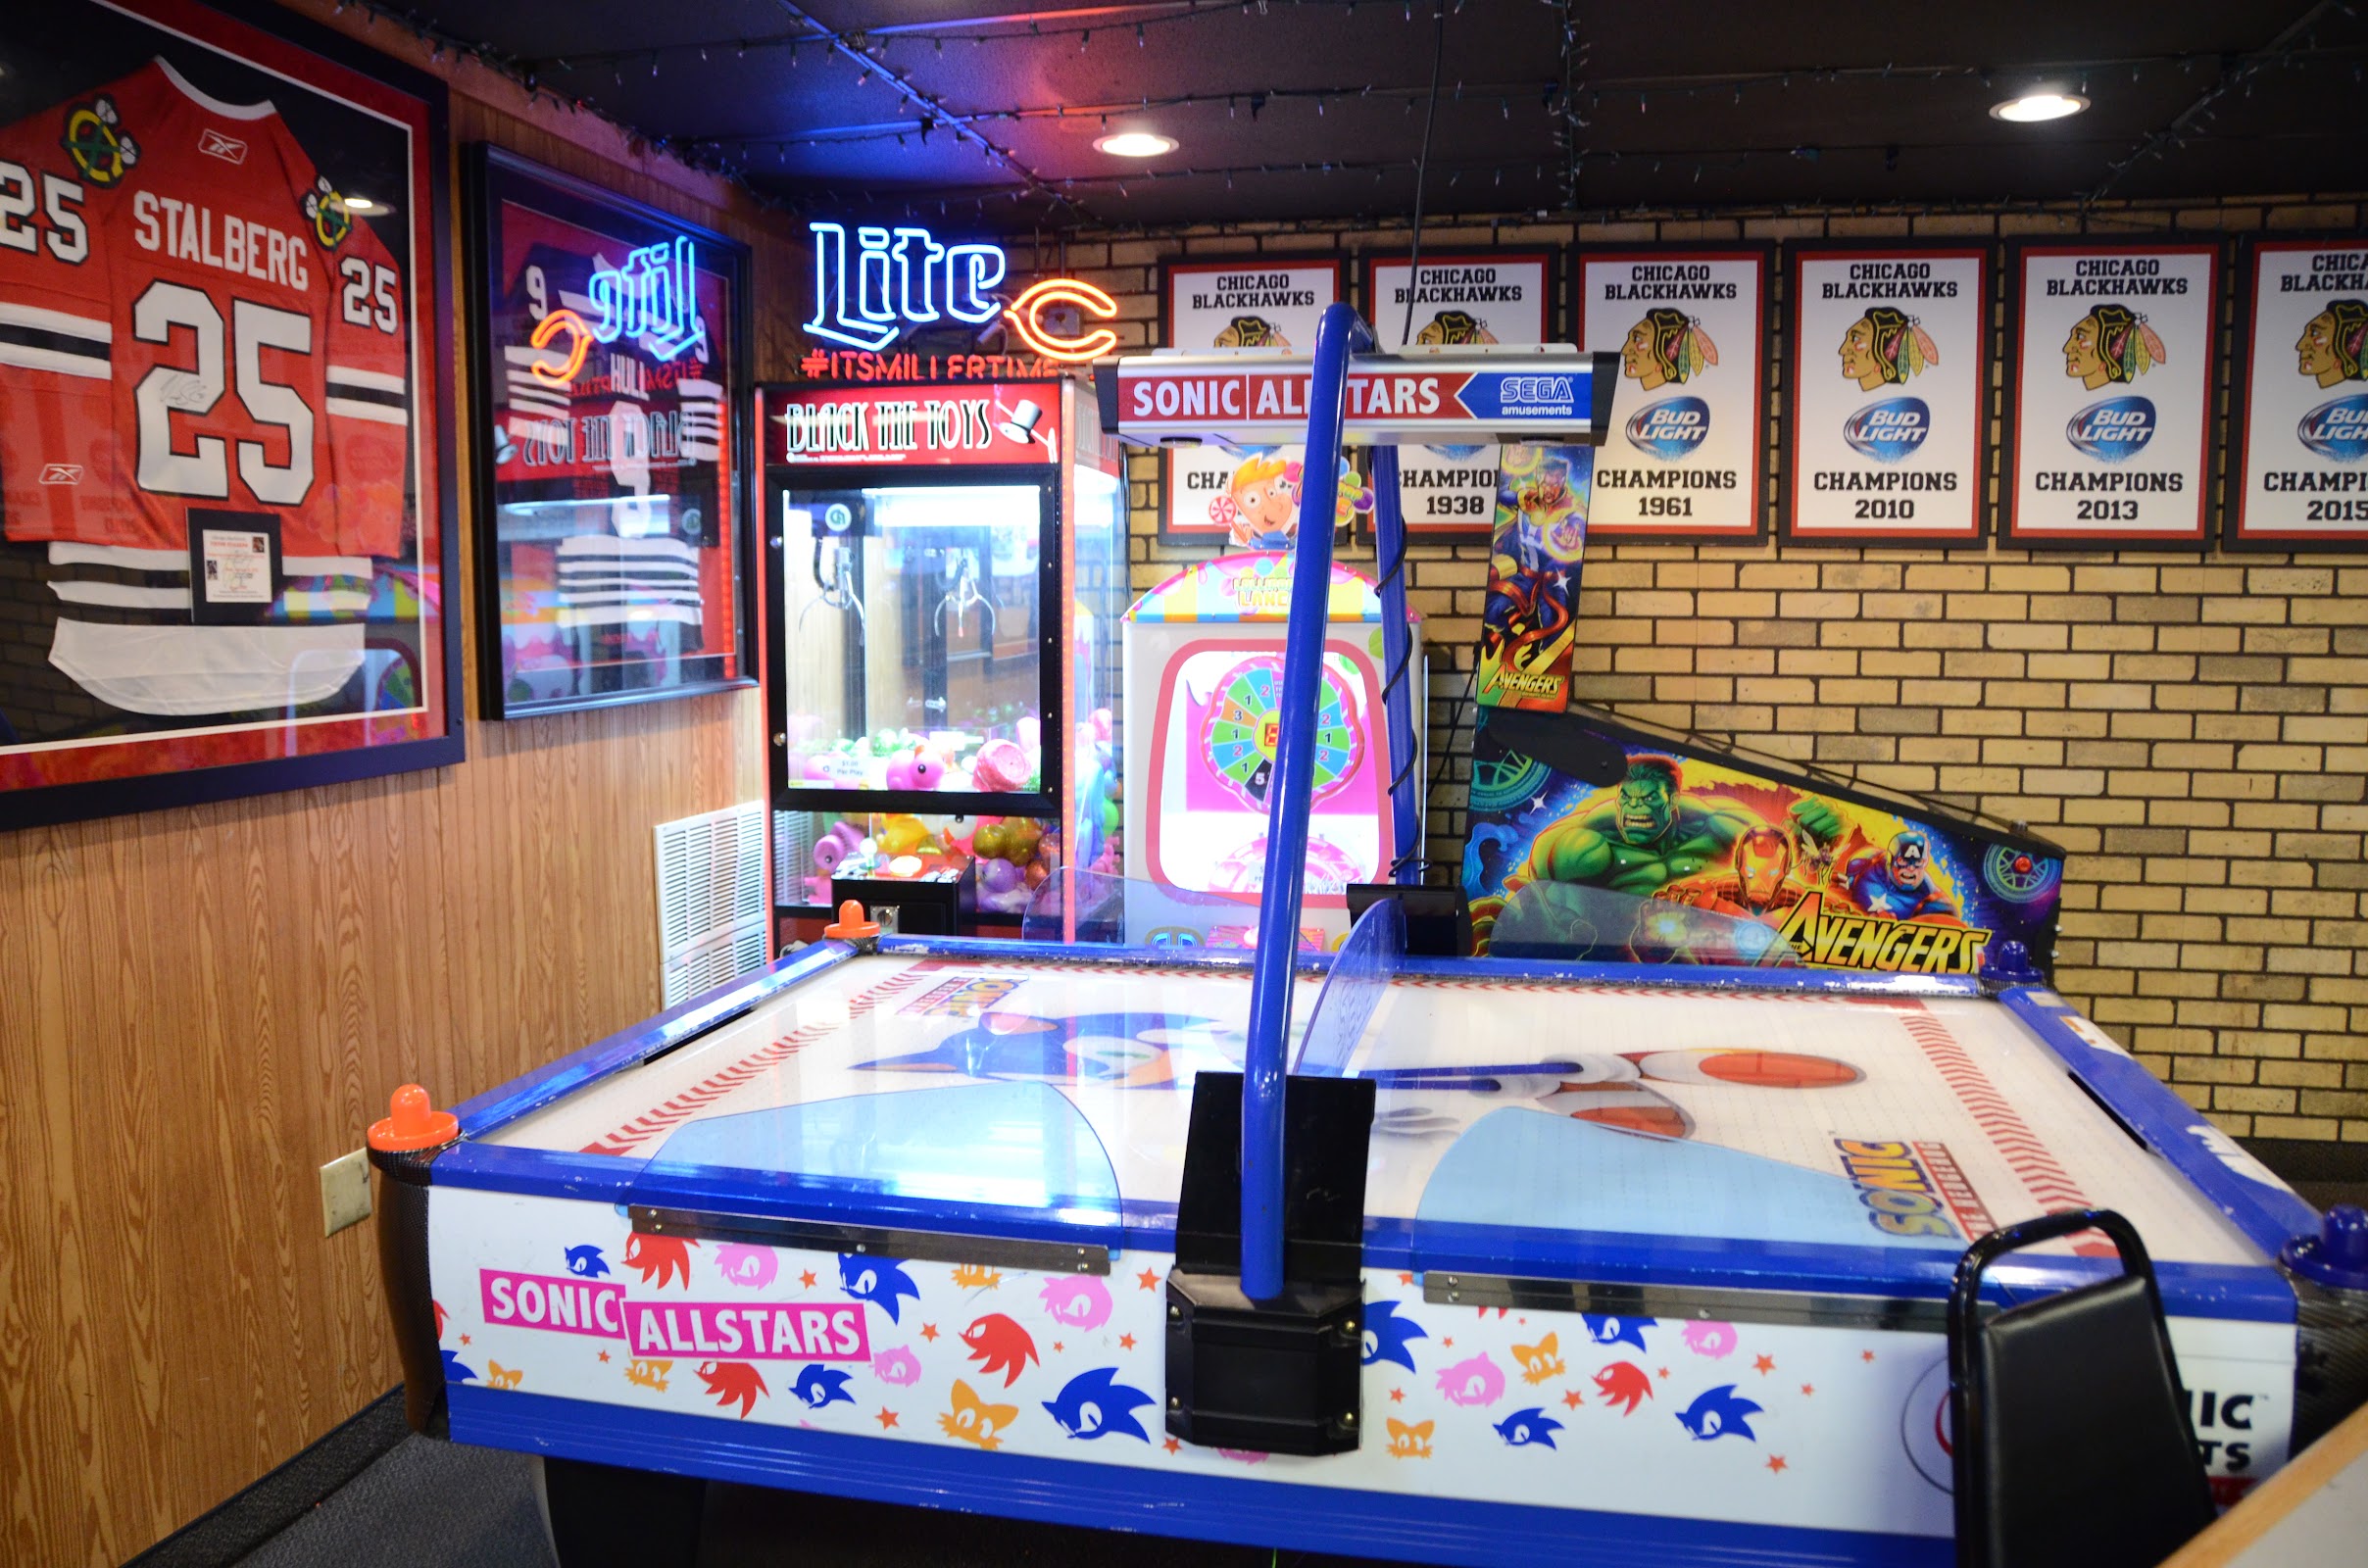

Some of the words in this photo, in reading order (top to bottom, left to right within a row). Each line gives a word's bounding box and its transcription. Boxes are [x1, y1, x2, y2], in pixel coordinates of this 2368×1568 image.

[0, 159, 89, 266] 25
[133, 189, 309, 292] STALBERG
[1850, 263, 1931, 280] CHICAGO
[2076, 260, 2159, 276] CHICAGO
[2312, 254, 2368, 271] CHICA
[1217, 274, 1289, 291] CHICAGO
[1420, 268, 1496, 285] CHICAGO
[1632, 265, 1710, 282] CHICAGO
[2281, 273, 2368, 292] BLACKH
[339, 257, 399, 335] 25
[803, 222, 1006, 351] Lite
[1604, 283, 1737, 300] BLACKHAWKS
[1822, 282, 1958, 300] BLACKHAWKS
[2047, 278, 2188, 296] BLACKHAWKS
[1193, 291, 1314, 310] BLACKHAWKS
[132, 277, 315, 506] 25
[1133, 380, 1240, 417] SONIC
[1501, 376, 1574, 404] SEGA
[1502, 406, 1572, 416] amusements
[1650, 410, 1702, 425] BUD
[1869, 410, 1921, 426] BUD
[2093, 410, 2146, 425] BUD
[785, 401, 870, 453] BLACK
[875, 400, 917, 451] TIE
[924, 399, 994, 450] TOYS
[1639, 425, 1706, 441] LIGHT
[1858, 425, 1927, 442] LIGHT
[2080, 425, 2152, 442] LIGHT
[2313, 424, 2368, 440] LIGH
[1597, 470, 1737, 489] CHAMPIONS
[1813, 471, 1958, 492] CHAMPIONS
[2035, 472, 2184, 492] CHAMPIONS
[2264, 472, 2368, 492] CHAMPI
[1426, 495, 1485, 515] 1938
[1638, 497, 1693, 516] 1961
[1854, 499, 1914, 519] 2010
[2077, 500, 2139, 520] 2013
[2306, 500, 2368, 521] 2015
[1482, 663, 1565, 695] AVENGERS
[1772, 889, 1993, 973] AVENGERS
[1834, 1139, 1960, 1239] SONIC
[490, 1278, 619, 1334] SONIC
[637, 1308, 862, 1356] ALLSTARS
